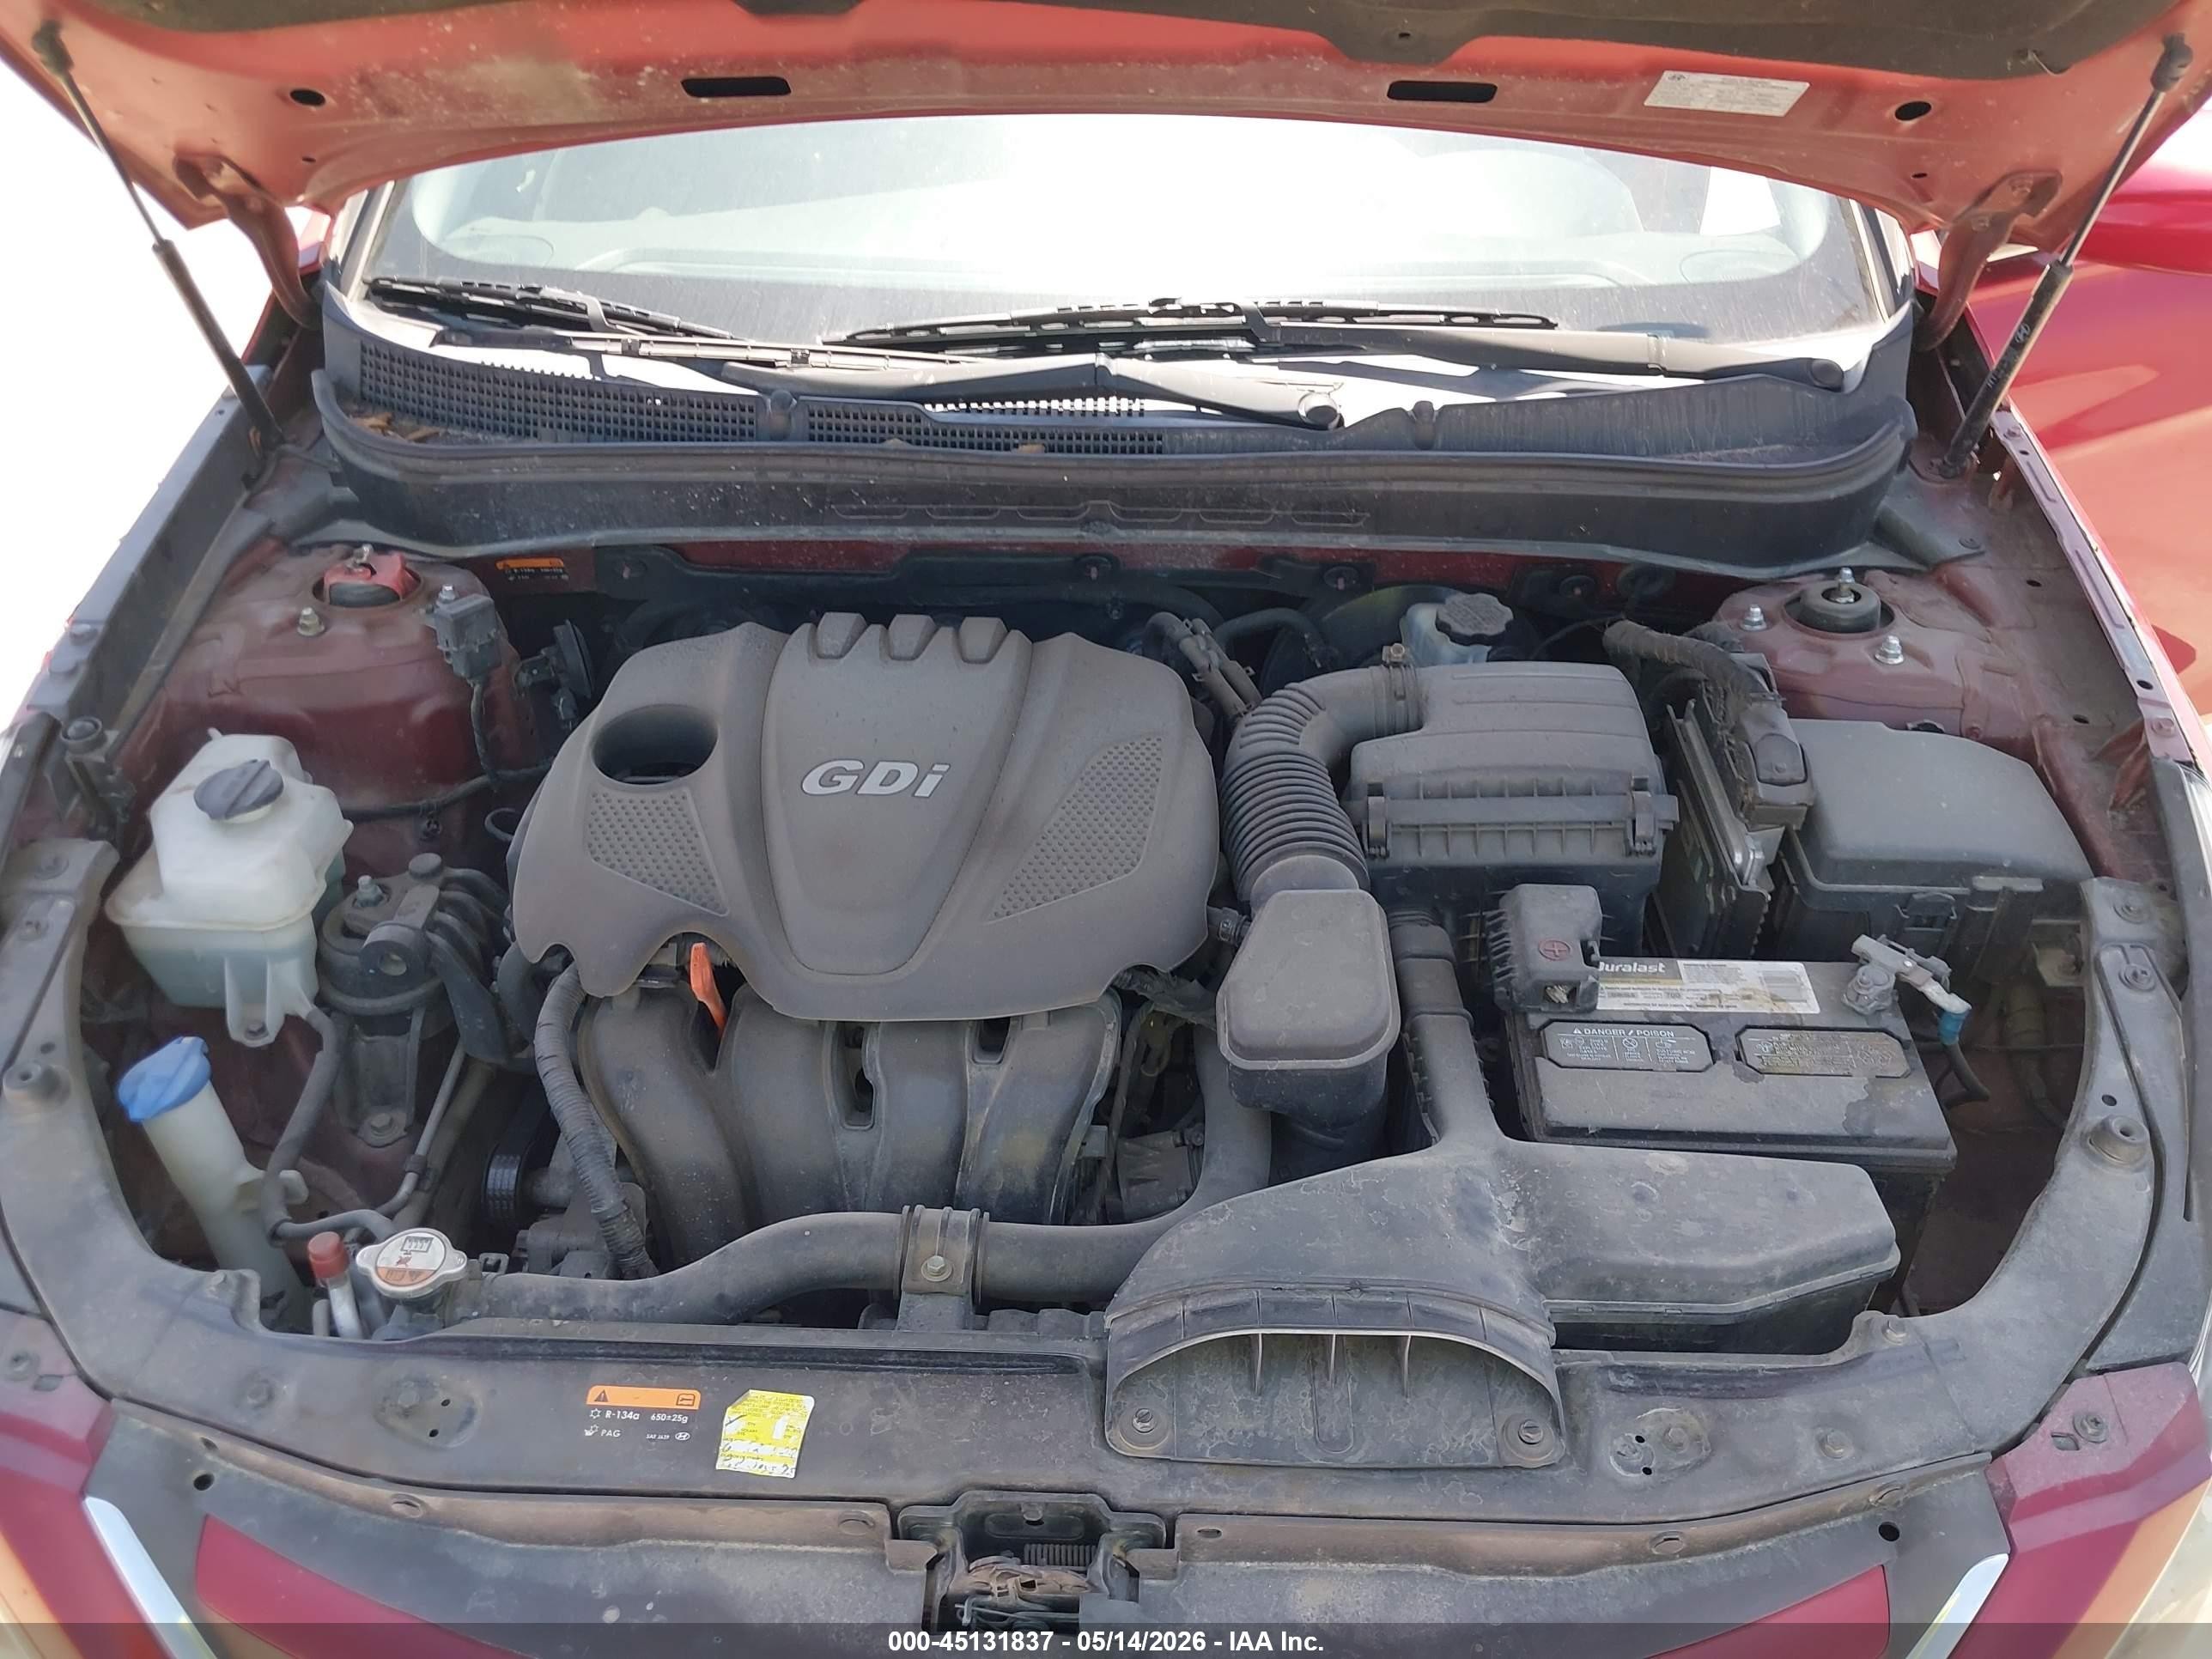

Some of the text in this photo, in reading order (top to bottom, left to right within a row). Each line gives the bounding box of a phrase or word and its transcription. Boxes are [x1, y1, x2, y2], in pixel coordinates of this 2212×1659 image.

[801, 759, 951, 798] GDi
[1583, 1028, 1626, 1036] DANGER
[605, 1410, 689, 1424] R-134a 650±25g
[600, 1429, 622, 1437] PAG
